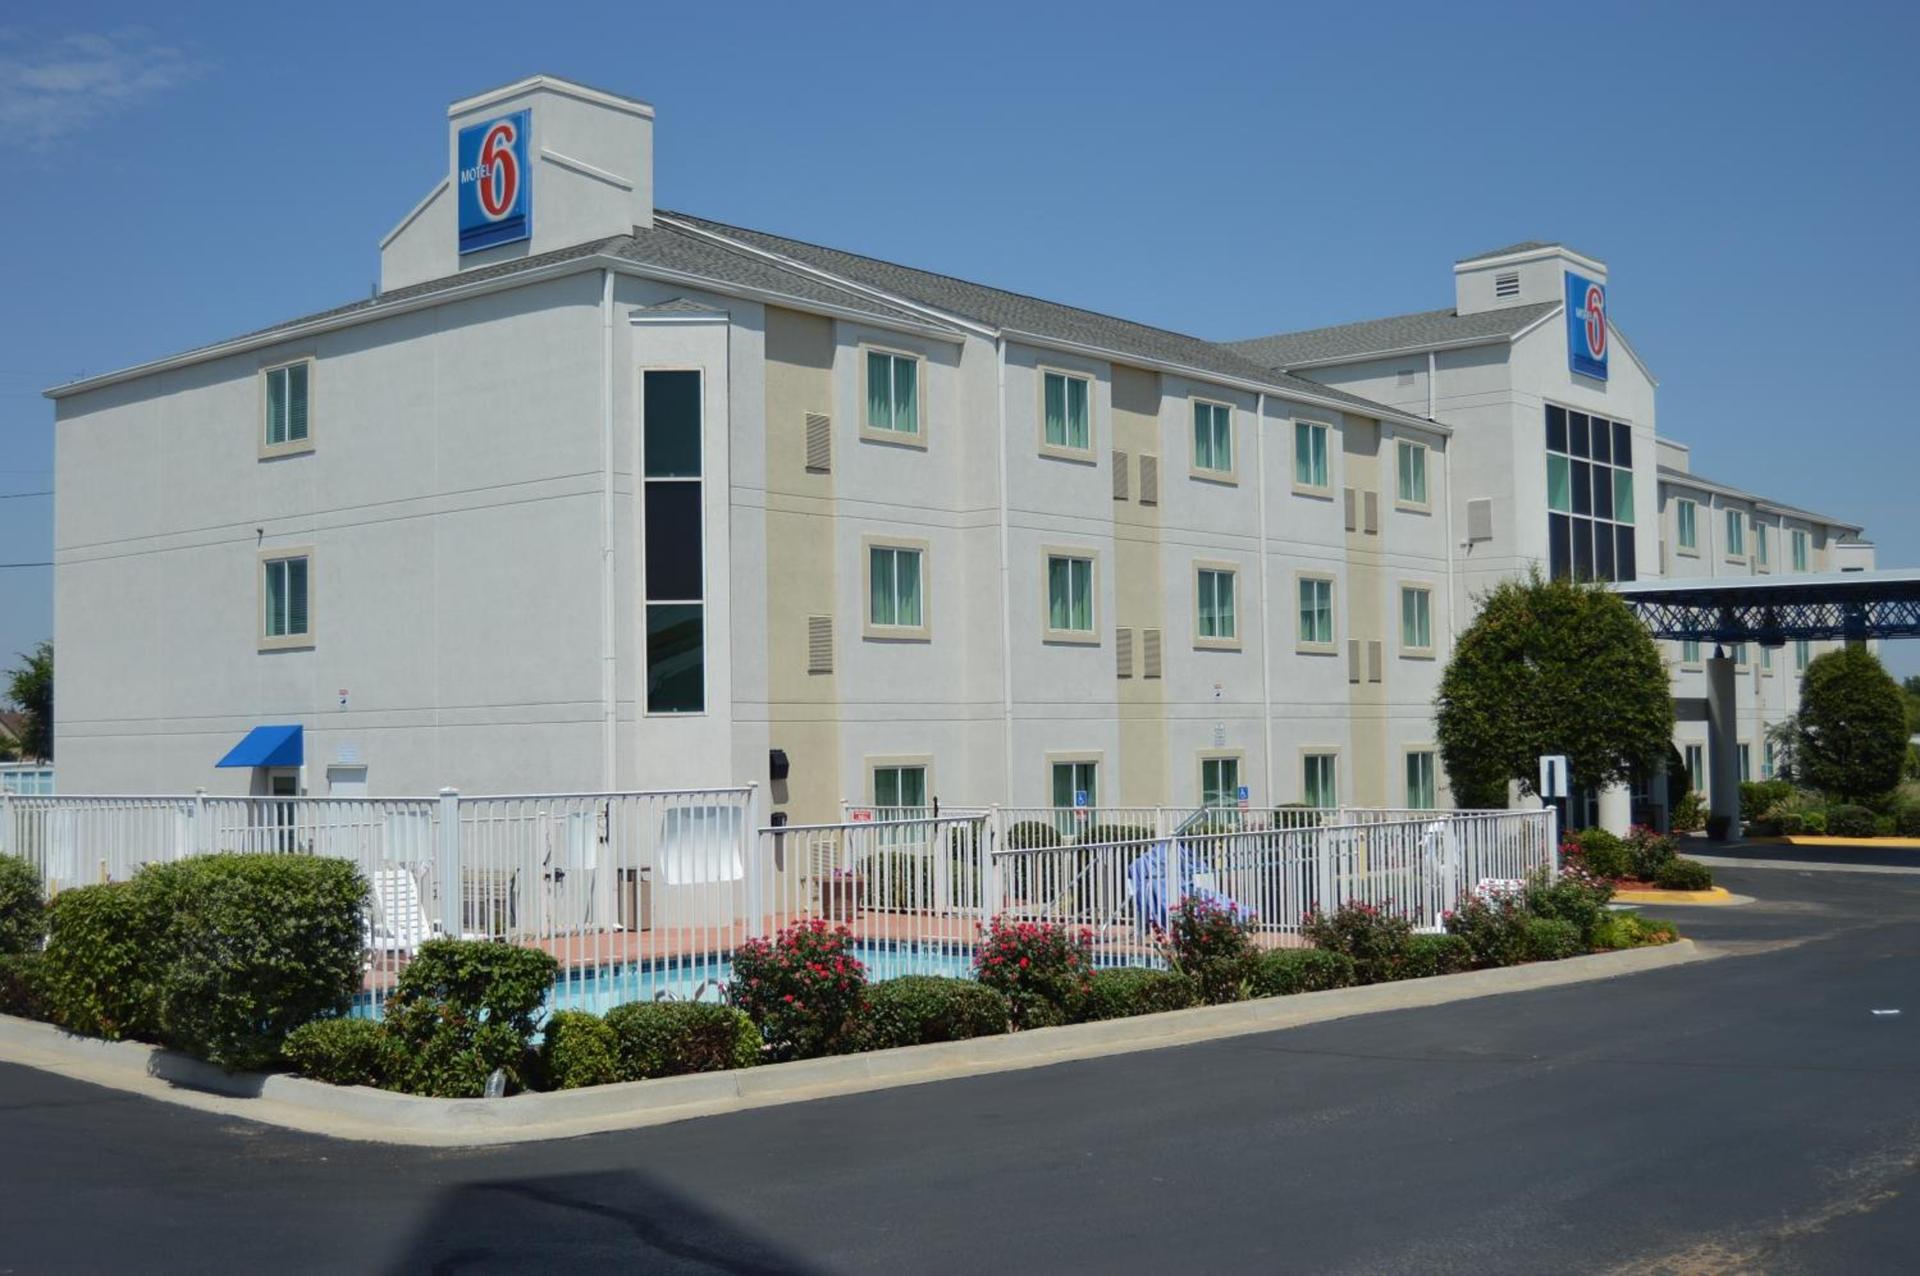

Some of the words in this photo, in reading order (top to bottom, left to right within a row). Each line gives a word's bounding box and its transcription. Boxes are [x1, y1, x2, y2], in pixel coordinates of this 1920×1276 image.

[461, 164, 491, 185] MOTEL
[478, 121, 518, 219] 6
[1586, 285, 1605, 358] 6
